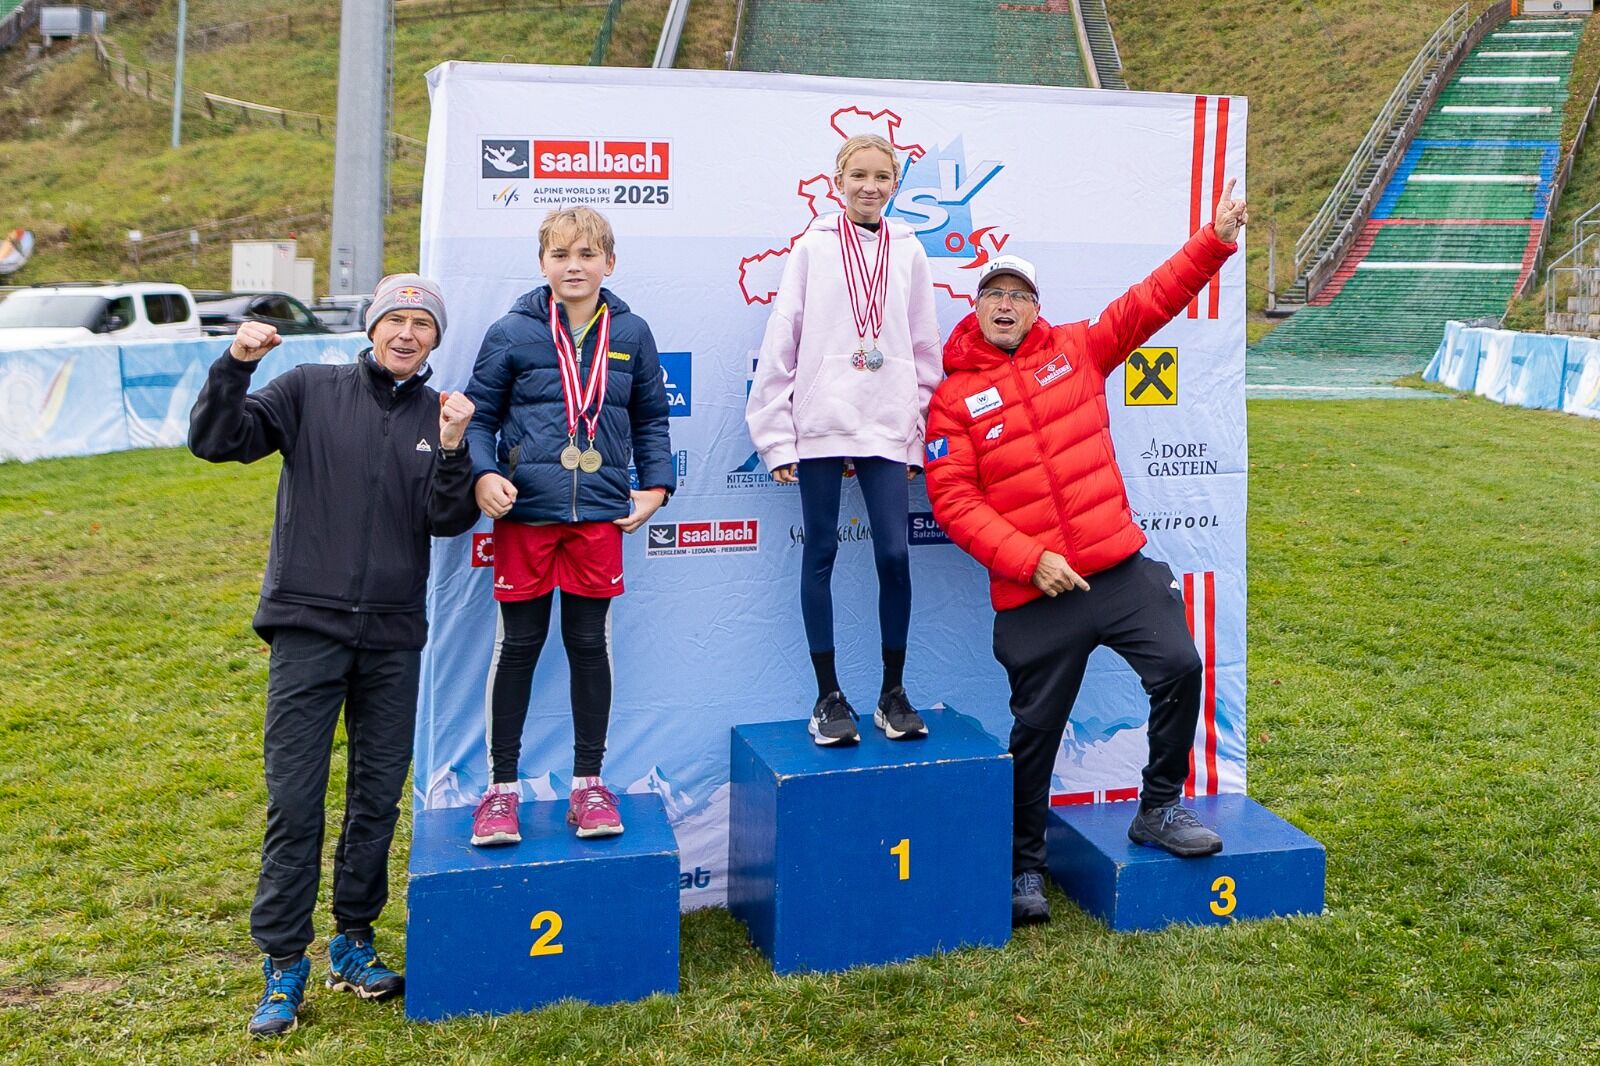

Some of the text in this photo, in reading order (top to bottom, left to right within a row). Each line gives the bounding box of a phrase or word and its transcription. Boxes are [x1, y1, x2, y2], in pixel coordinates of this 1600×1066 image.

[540, 140, 662, 174] saalbach
[533, 187, 611, 196] ALPINE WORLD SKI
[533, 196, 611, 204] CHAMPIONSHIPS
[613, 185, 670, 205] 2025
[985, 423, 1004, 440] 4F
[1161, 443, 1208, 459] DORF
[1147, 460, 1218, 477] GASTEIN
[726, 473, 774, 484] KITZSTEIN
[1139, 514, 1220, 531] SKIPOOL
[681, 521, 754, 544] saalbach
[890, 838, 910, 881] 1
[680, 866, 712, 890] at
[1209, 875, 1238, 917] 3
[529, 910, 564, 957] 2
